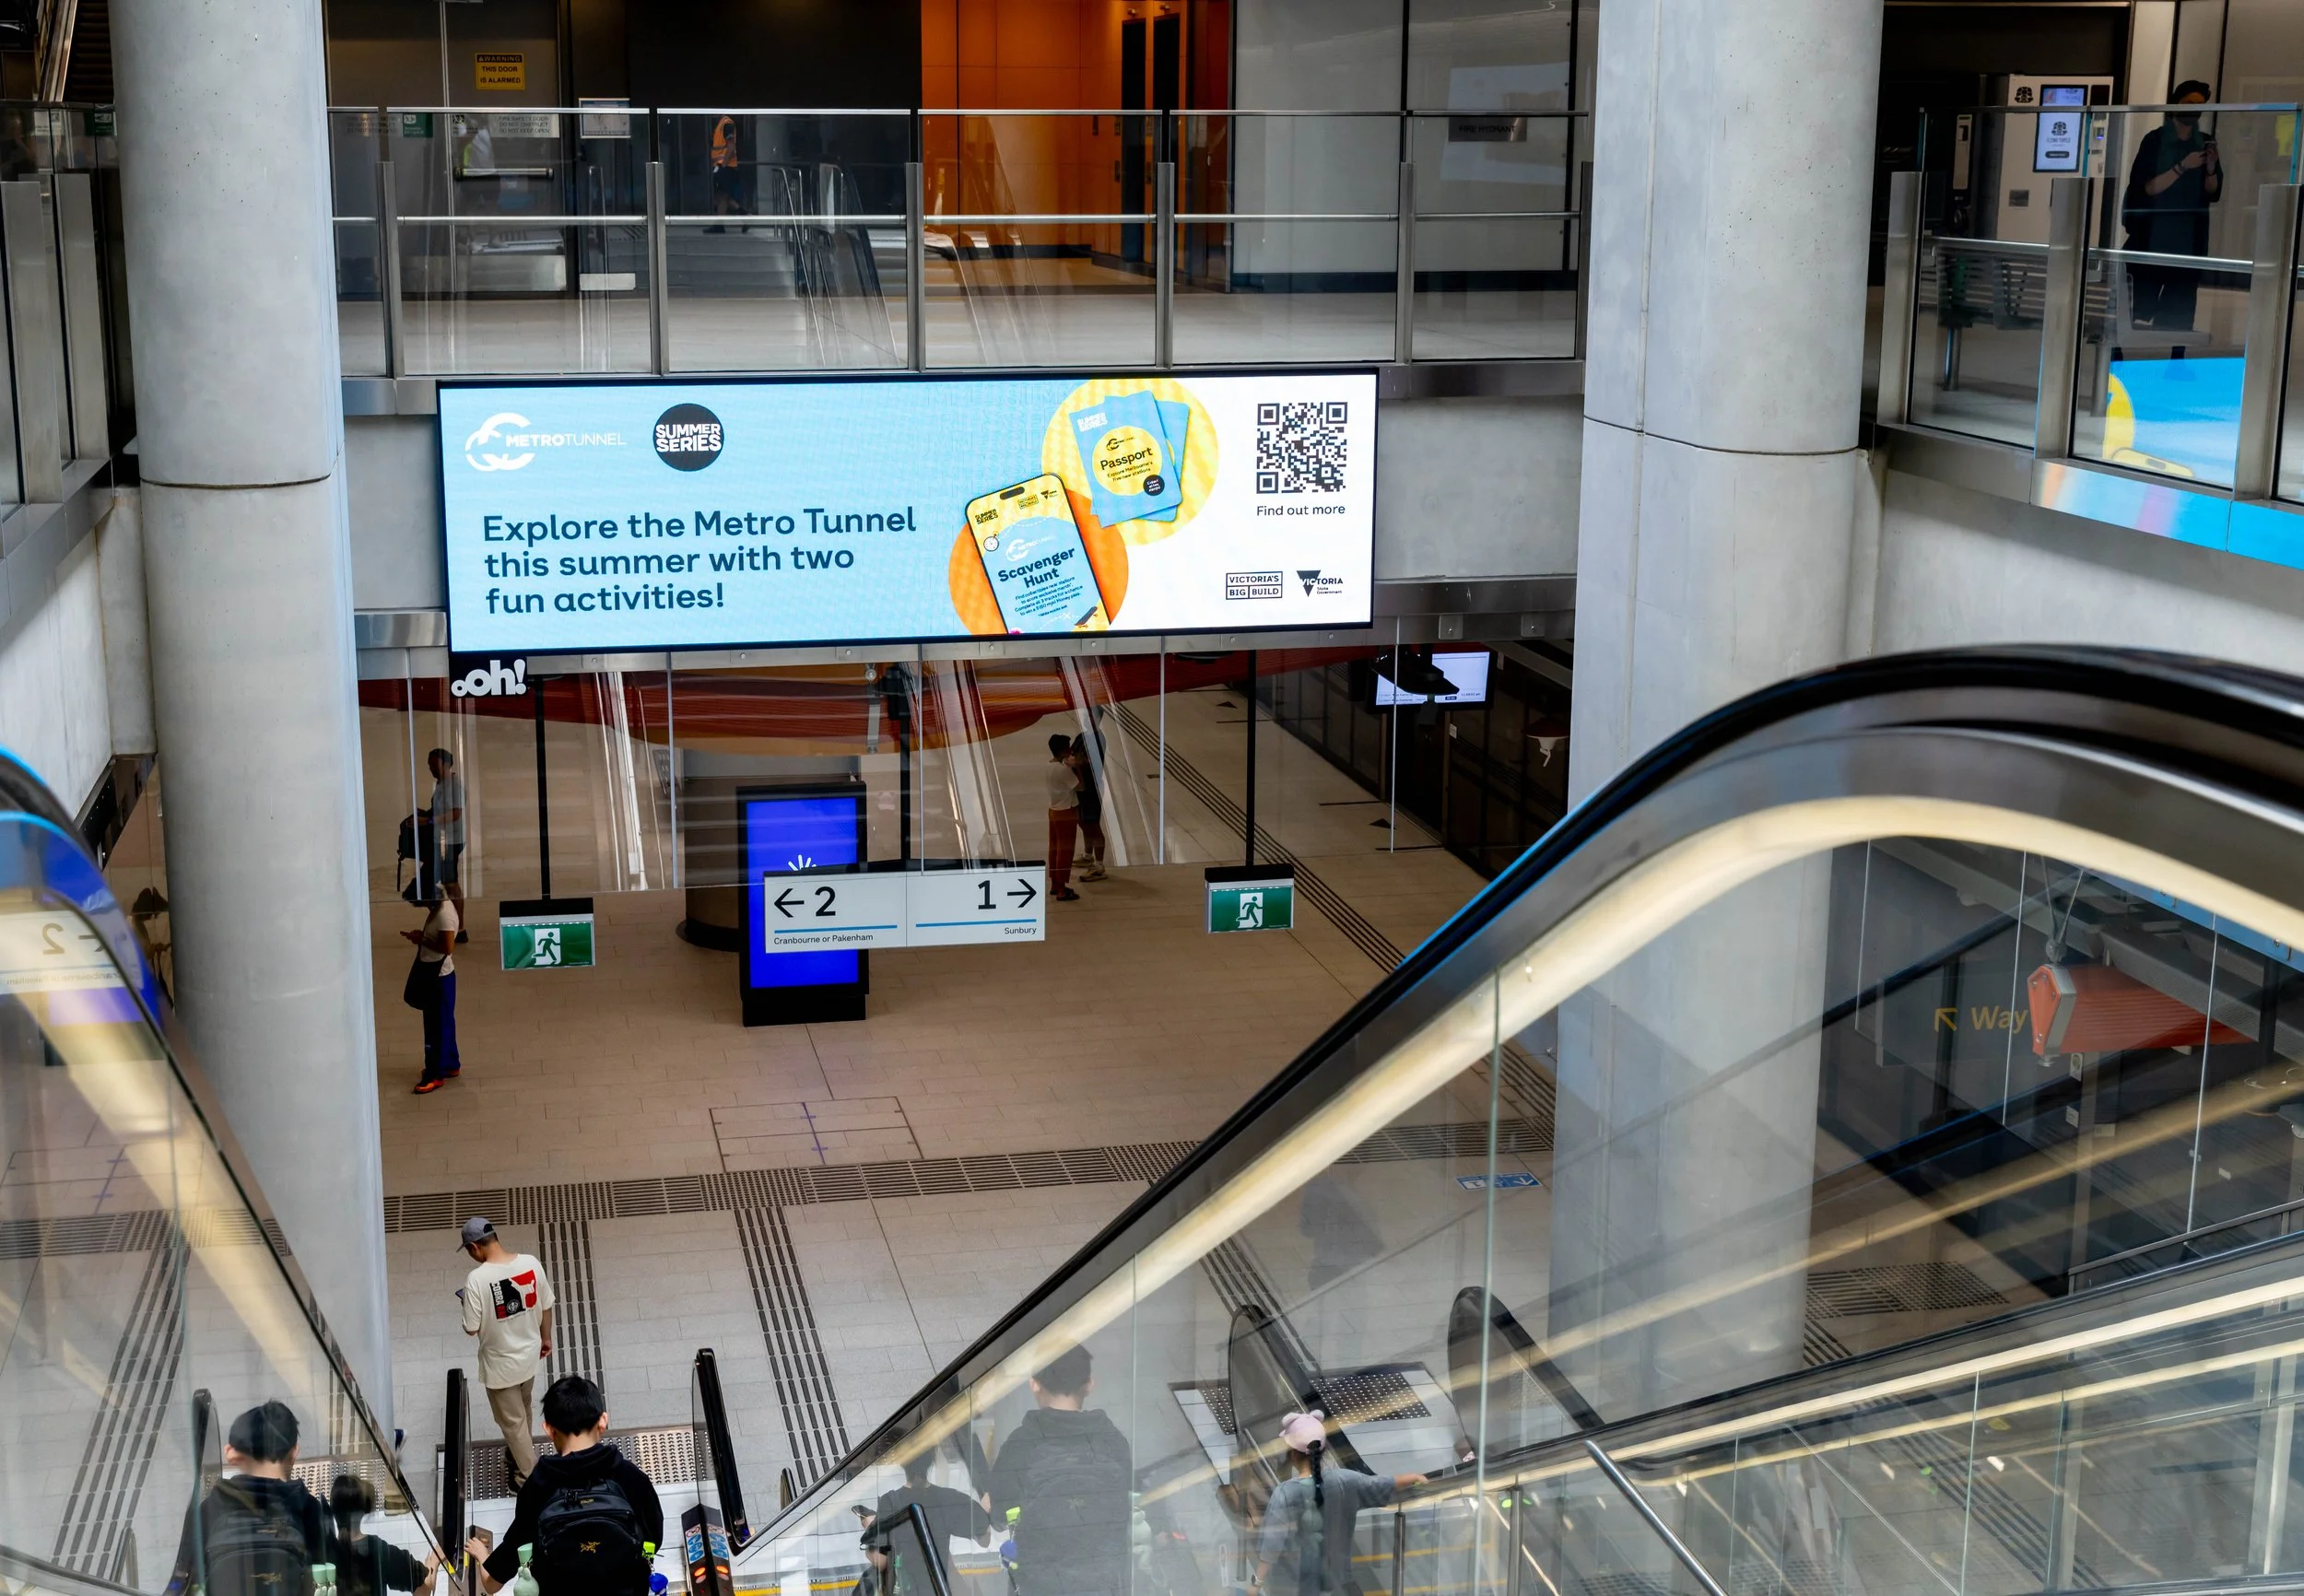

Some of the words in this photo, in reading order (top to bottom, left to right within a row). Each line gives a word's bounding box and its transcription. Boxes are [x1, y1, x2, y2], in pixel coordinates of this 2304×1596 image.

[655, 423, 722, 439] SUMMER
[656, 435, 723, 453] SERIES
[1100, 447, 1153, 470] Passport
[1257, 506, 1283, 515] Find
[1287, 506, 1309, 515] out
[1313, 506, 1345, 514] more
[484, 515, 617, 547] Explore
[628, 512, 685, 538] the
[695, 510, 794, 535] Metro
[804, 507, 916, 534] Tunnel
[485, 551, 548, 577] this
[560, 554, 699, 575] summer
[709, 546, 781, 571] with
[791, 547, 853, 569] two
[998, 548, 1075, 581] Scavenger
[1024, 568, 1059, 588] Hunt
[1229, 575, 1279, 583] VICTORIA'S
[1300, 577, 1343, 585] VICTORIA
[486, 588, 544, 614] fun
[555, 582, 723, 612] activities!
[1252, 587, 1279, 595] BUILD
[816, 886, 835, 916] 2
[979, 880, 996, 909] 1
[1970, 1005, 2028, 1034] Way
[491, 1281, 505, 1306] COBRA
